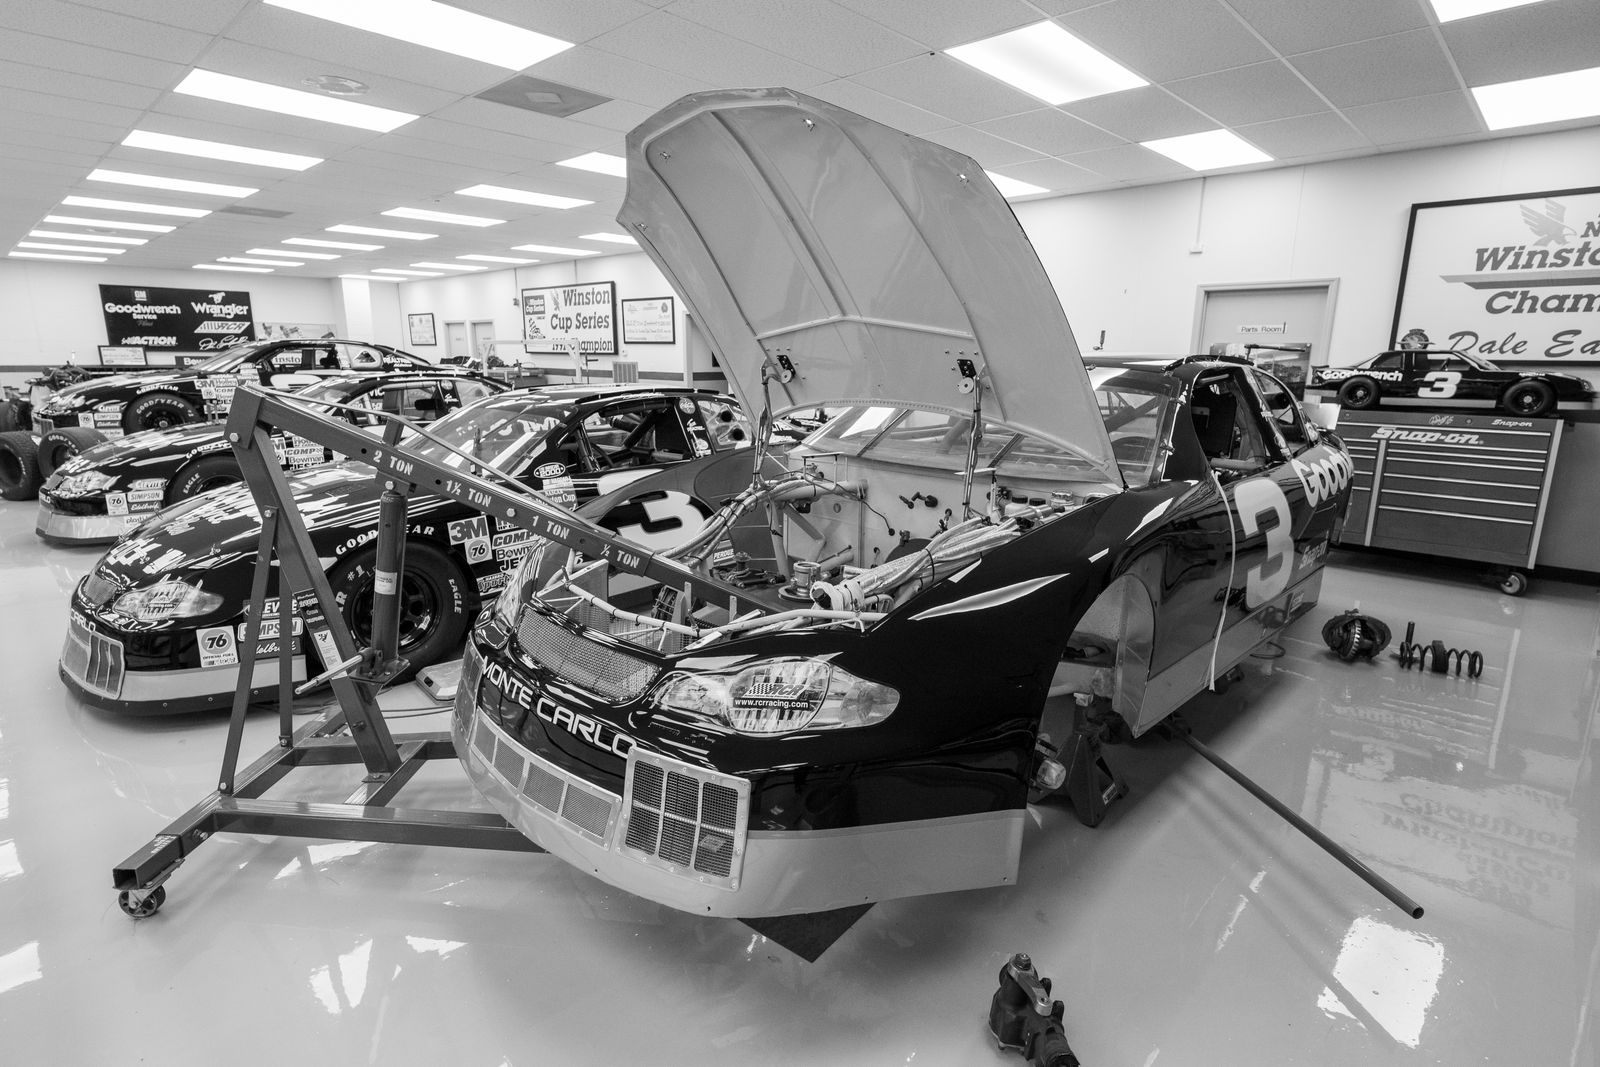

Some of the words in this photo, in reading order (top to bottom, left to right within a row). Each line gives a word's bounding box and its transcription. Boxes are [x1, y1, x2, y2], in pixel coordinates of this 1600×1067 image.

[563, 287, 610, 307] Winston
[1486, 291, 1600, 315] Cham
[105, 303, 181, 315] Goodwrench
[191, 302, 249, 319] Wrangler
[551, 313, 572, 333] Cup
[575, 312, 610, 329] Series
[1449, 331, 1528, 354] Dale
[1417, 371, 1462, 398] 3
[1490, 418, 1533, 427] Snap-on
[1371, 426, 1479, 444] Snap-on
[287, 448, 315, 456] COMP
[373, 450, 382, 463] 2
[390, 456, 414, 476] TON
[183, 472, 200, 494] EAGLE
[468, 488, 491, 507] TON
[563, 493, 576, 503] Cup
[450, 517, 488, 542] 3M
[532, 515, 539, 527] 1
[546, 520, 570, 540] TON
[472, 544, 486, 557] 76
[1234, 477, 1294, 608] 3
[616, 550, 640, 569] TON
[448, 578, 463, 614] EAGLE
[206, 634, 228, 649] 76
[482, 655, 534, 710] MONTE
[769, 684, 806, 696] RCR
[734, 699, 809, 708] www.rcrracing.com
[536, 697, 638, 760] CARLO
